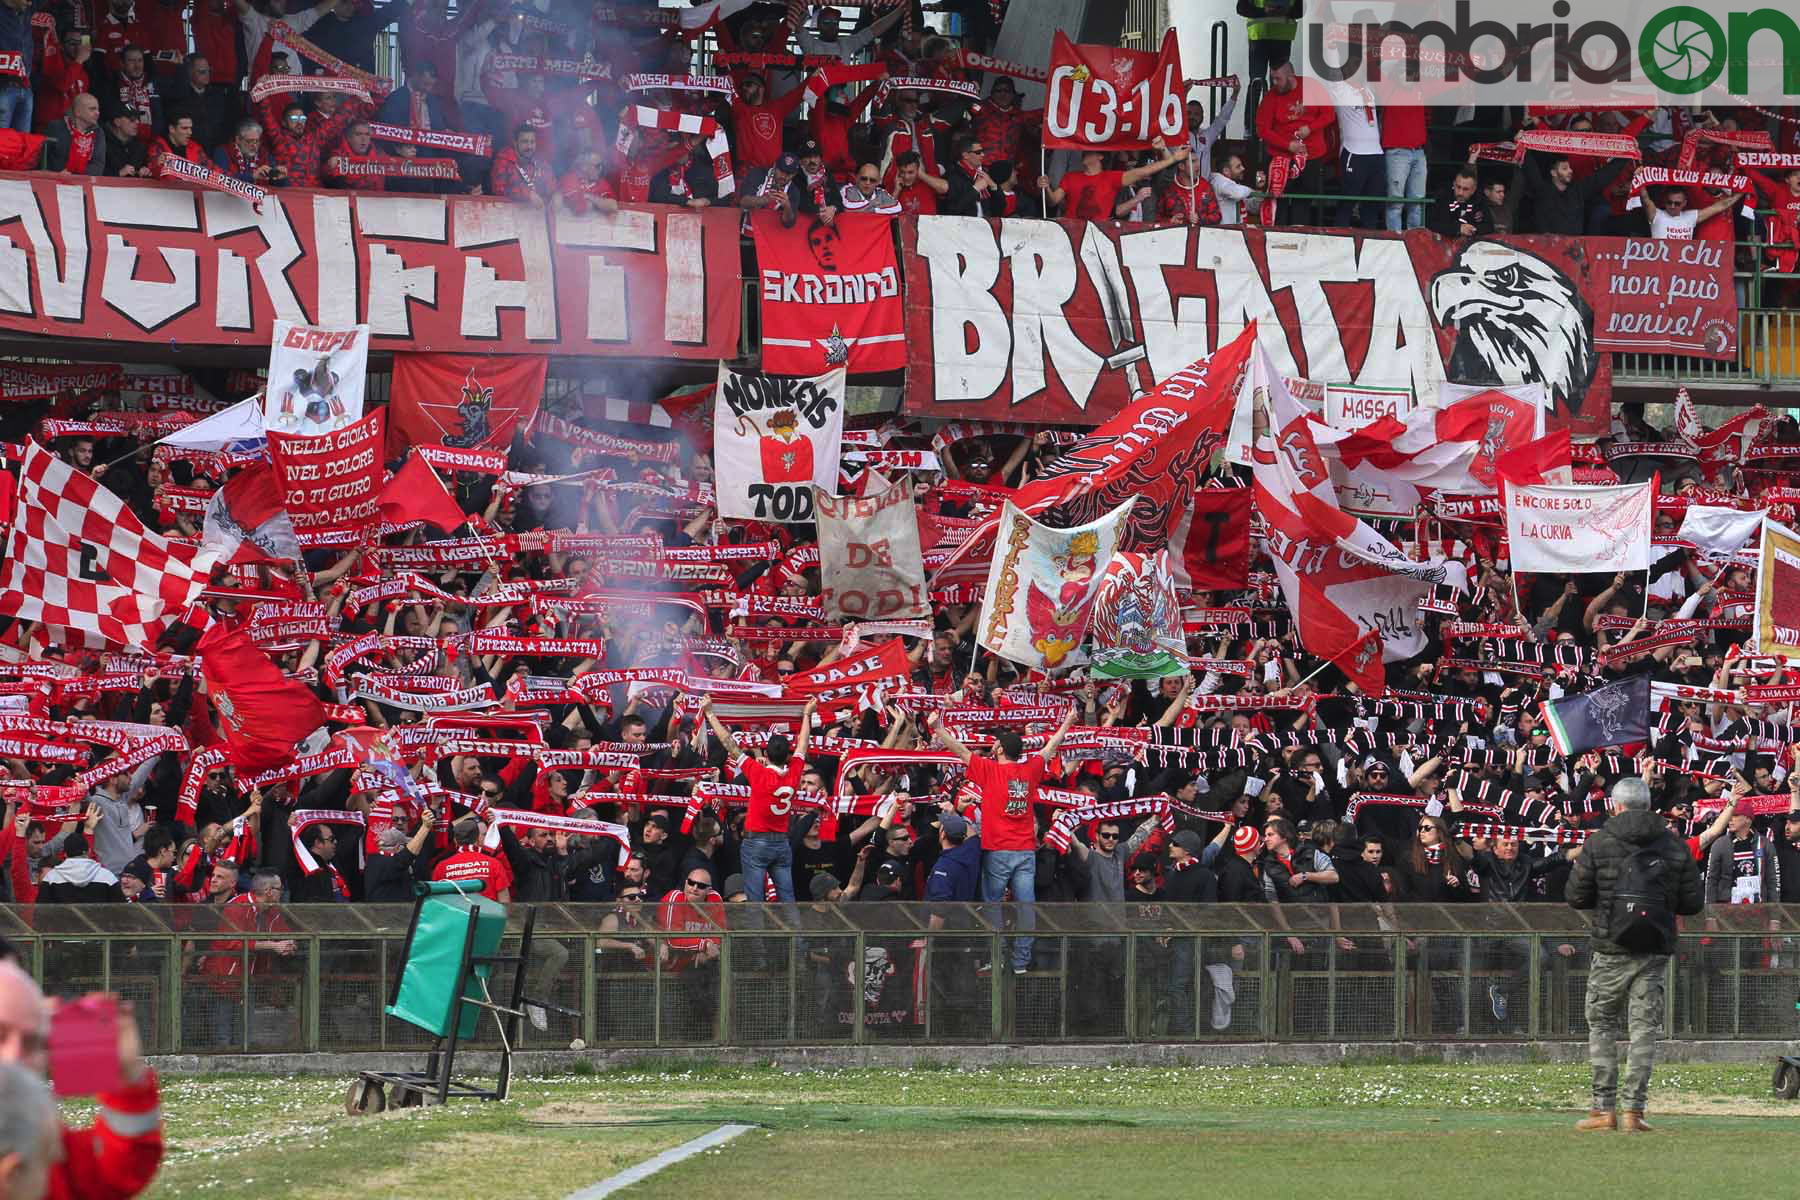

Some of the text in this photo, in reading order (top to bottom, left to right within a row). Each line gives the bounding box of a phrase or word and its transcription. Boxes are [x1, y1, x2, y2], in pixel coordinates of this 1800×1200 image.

[629, 73, 669, 87] MASSA
[1738, 152, 1800, 167] SEMPRE
[217, 173, 265, 202] PERUGIA
[1678, 239, 1725, 268] chi
[1608, 273, 1719, 305] non può
[724, 373, 838, 428] MONKEYS
[279, 418, 380, 456] NELLA GIOIA E
[285, 447, 375, 481] NEL DOLORE
[284, 475, 371, 505] IO TI GIURO
[748, 483, 818, 522] TOD
[1562, 497, 1592, 511] SOLO
[1520, 521, 1573, 541] LA CURVA
[377, 543, 509, 564] TERNI MERDA
[665, 549, 769, 562] TERNI MERDA
[753, 601, 772, 613] AC
[278, 619, 329, 637] MERDA
[756, 631, 832, 639] PERUGIA
[477, 638, 598, 655] ETERNA MALATTIA
[808, 655, 884, 684] DAJE
[450, 687, 486, 706] 1905
[945, 710, 994, 722] TERNI
[997, 708, 1056, 721] MERDA
[301, 749, 355, 775] MALATTIA
[186, 748, 226, 800] ETERNA
[769, 786, 795, 817] 3
[445, 868, 490, 879] PRESENTI
